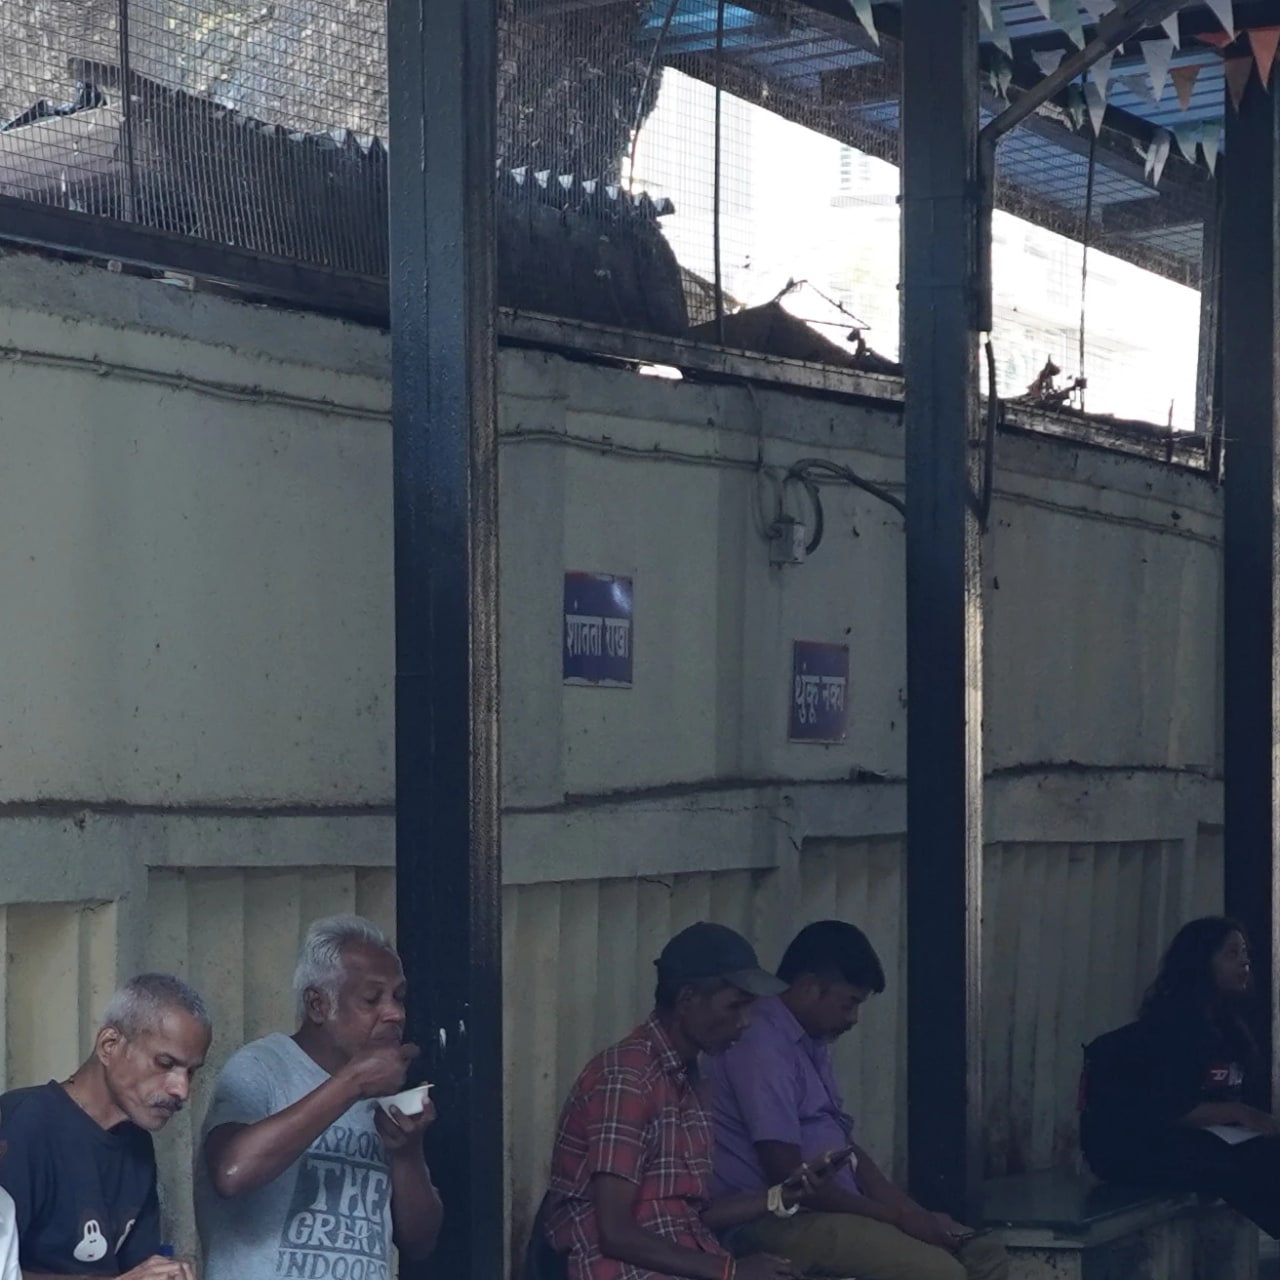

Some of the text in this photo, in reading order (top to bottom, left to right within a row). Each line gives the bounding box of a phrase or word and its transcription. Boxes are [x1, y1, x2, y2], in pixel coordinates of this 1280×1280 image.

[316, 1125, 384, 1162] XPLOR
[307, 1159, 388, 1223] THE
[287, 1211, 383, 1255] GREAT
